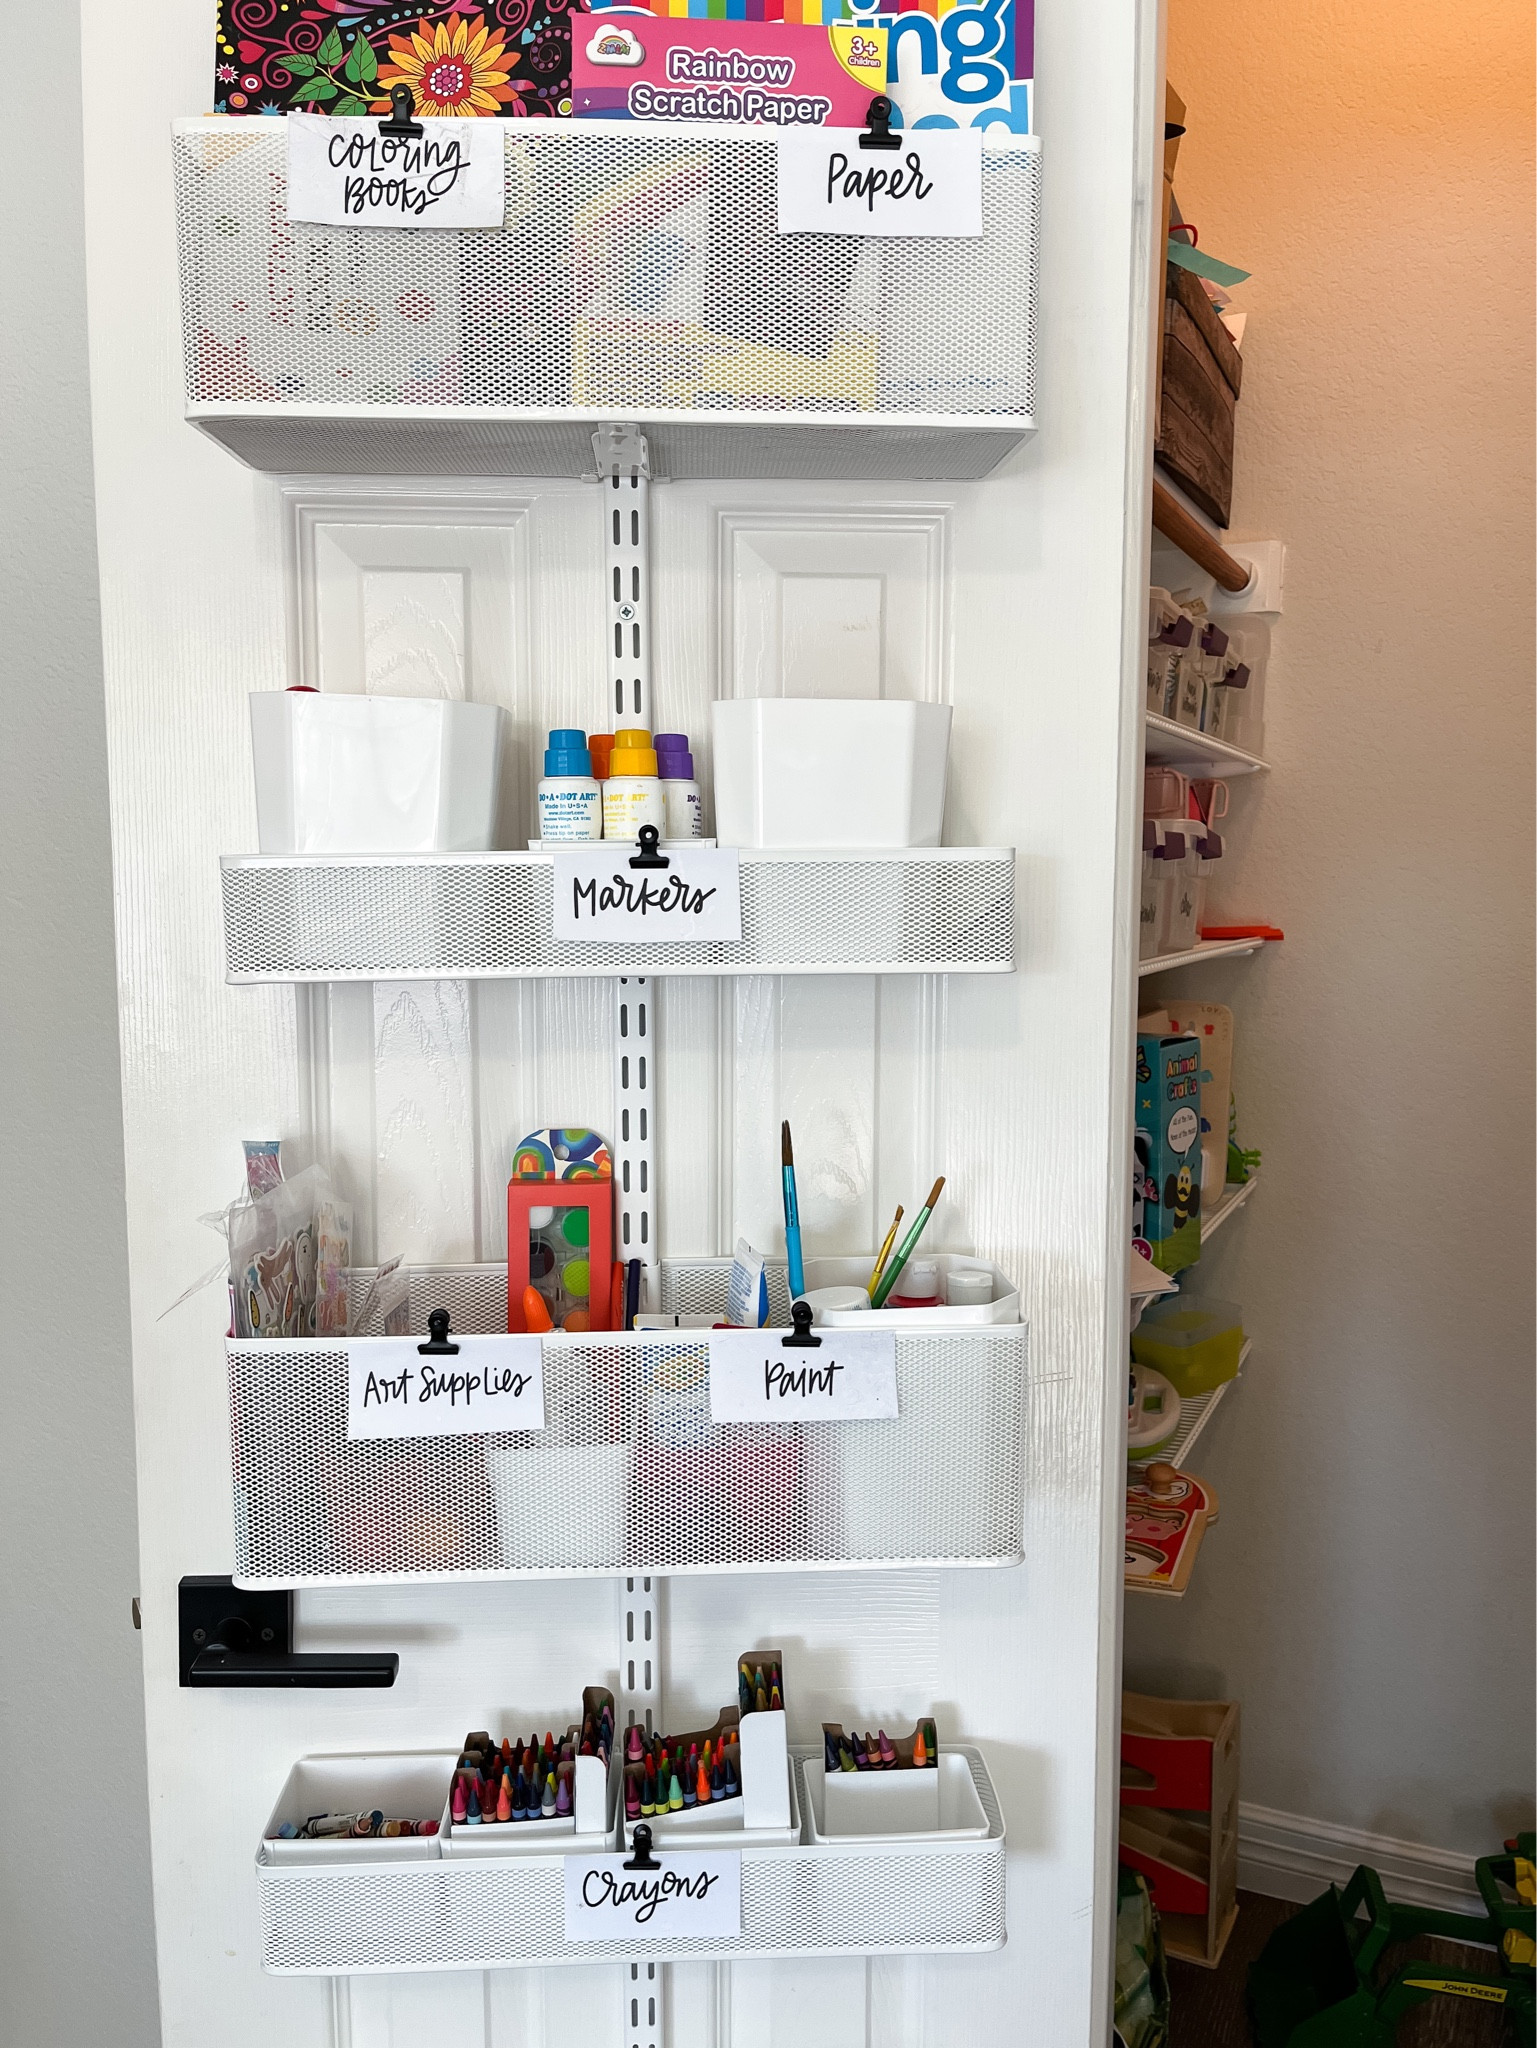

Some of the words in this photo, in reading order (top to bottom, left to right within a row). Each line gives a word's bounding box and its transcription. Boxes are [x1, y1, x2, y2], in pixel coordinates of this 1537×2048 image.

[851, 36, 878, 56] 3+
[670, 50, 792, 84] Rainbow
[632, 85, 741, 118] Scratch
[744, 91, 828, 126] Paper
[344, 175, 439, 215] Books
[826, 151, 933, 212] Paper
[573, 874, 717, 919] Markers
[1166, 1052, 1198, 1078] Animal
[1167, 1076, 1197, 1101] Crafts
[363, 1368, 415, 1408] Art
[764, 1359, 845, 1401] Paint
[582, 1869, 720, 1923] Crayons
[1441, 1982, 1468, 1993] JOHN
[1470, 1986, 1504, 1999] DEERE
